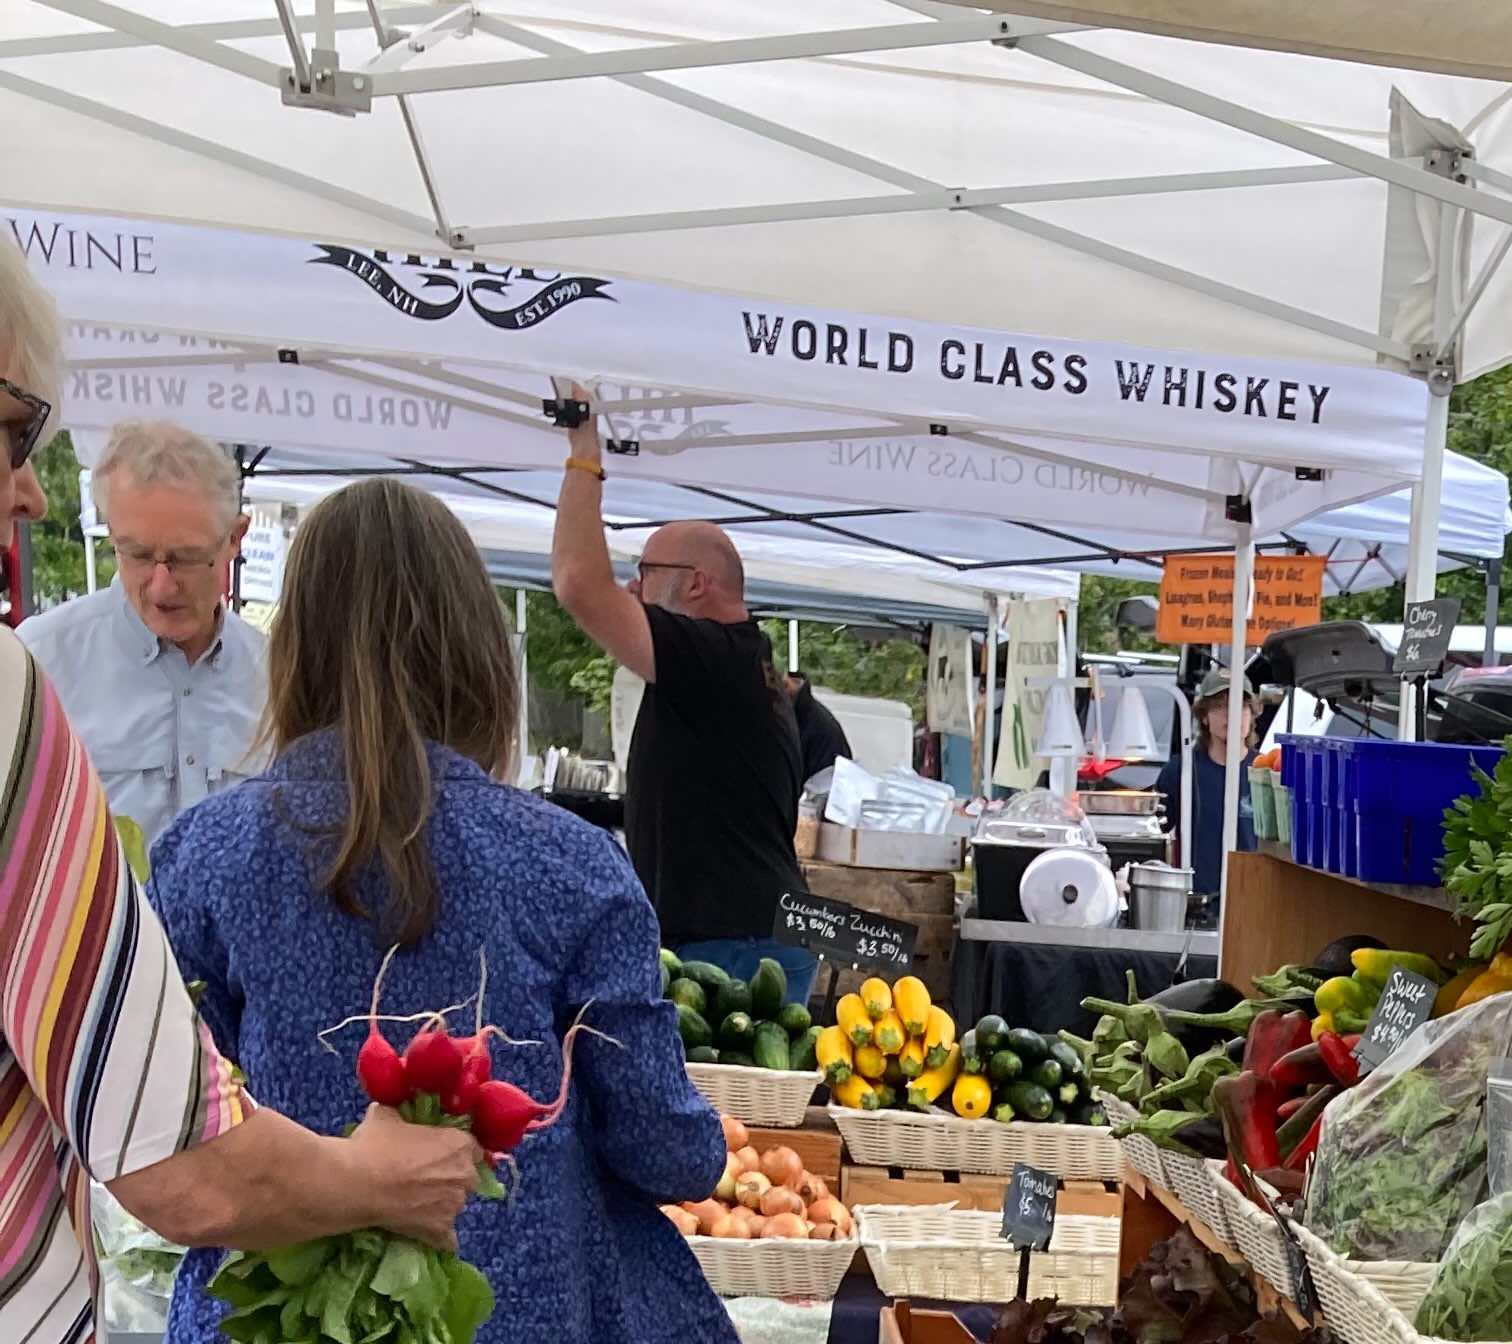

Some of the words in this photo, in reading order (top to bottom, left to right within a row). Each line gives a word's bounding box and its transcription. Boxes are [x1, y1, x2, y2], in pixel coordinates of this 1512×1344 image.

[7, 217, 157, 274] WINE
[387, 285, 418, 315] NH
[547, 282, 581, 306] 1990
[742, 312, 914, 373] WORLD
[940, 339, 1088, 395] CLASS
[1115, 360, 1330, 424] WHISKEY
[1390, 971, 1426, 1005] Sweet
